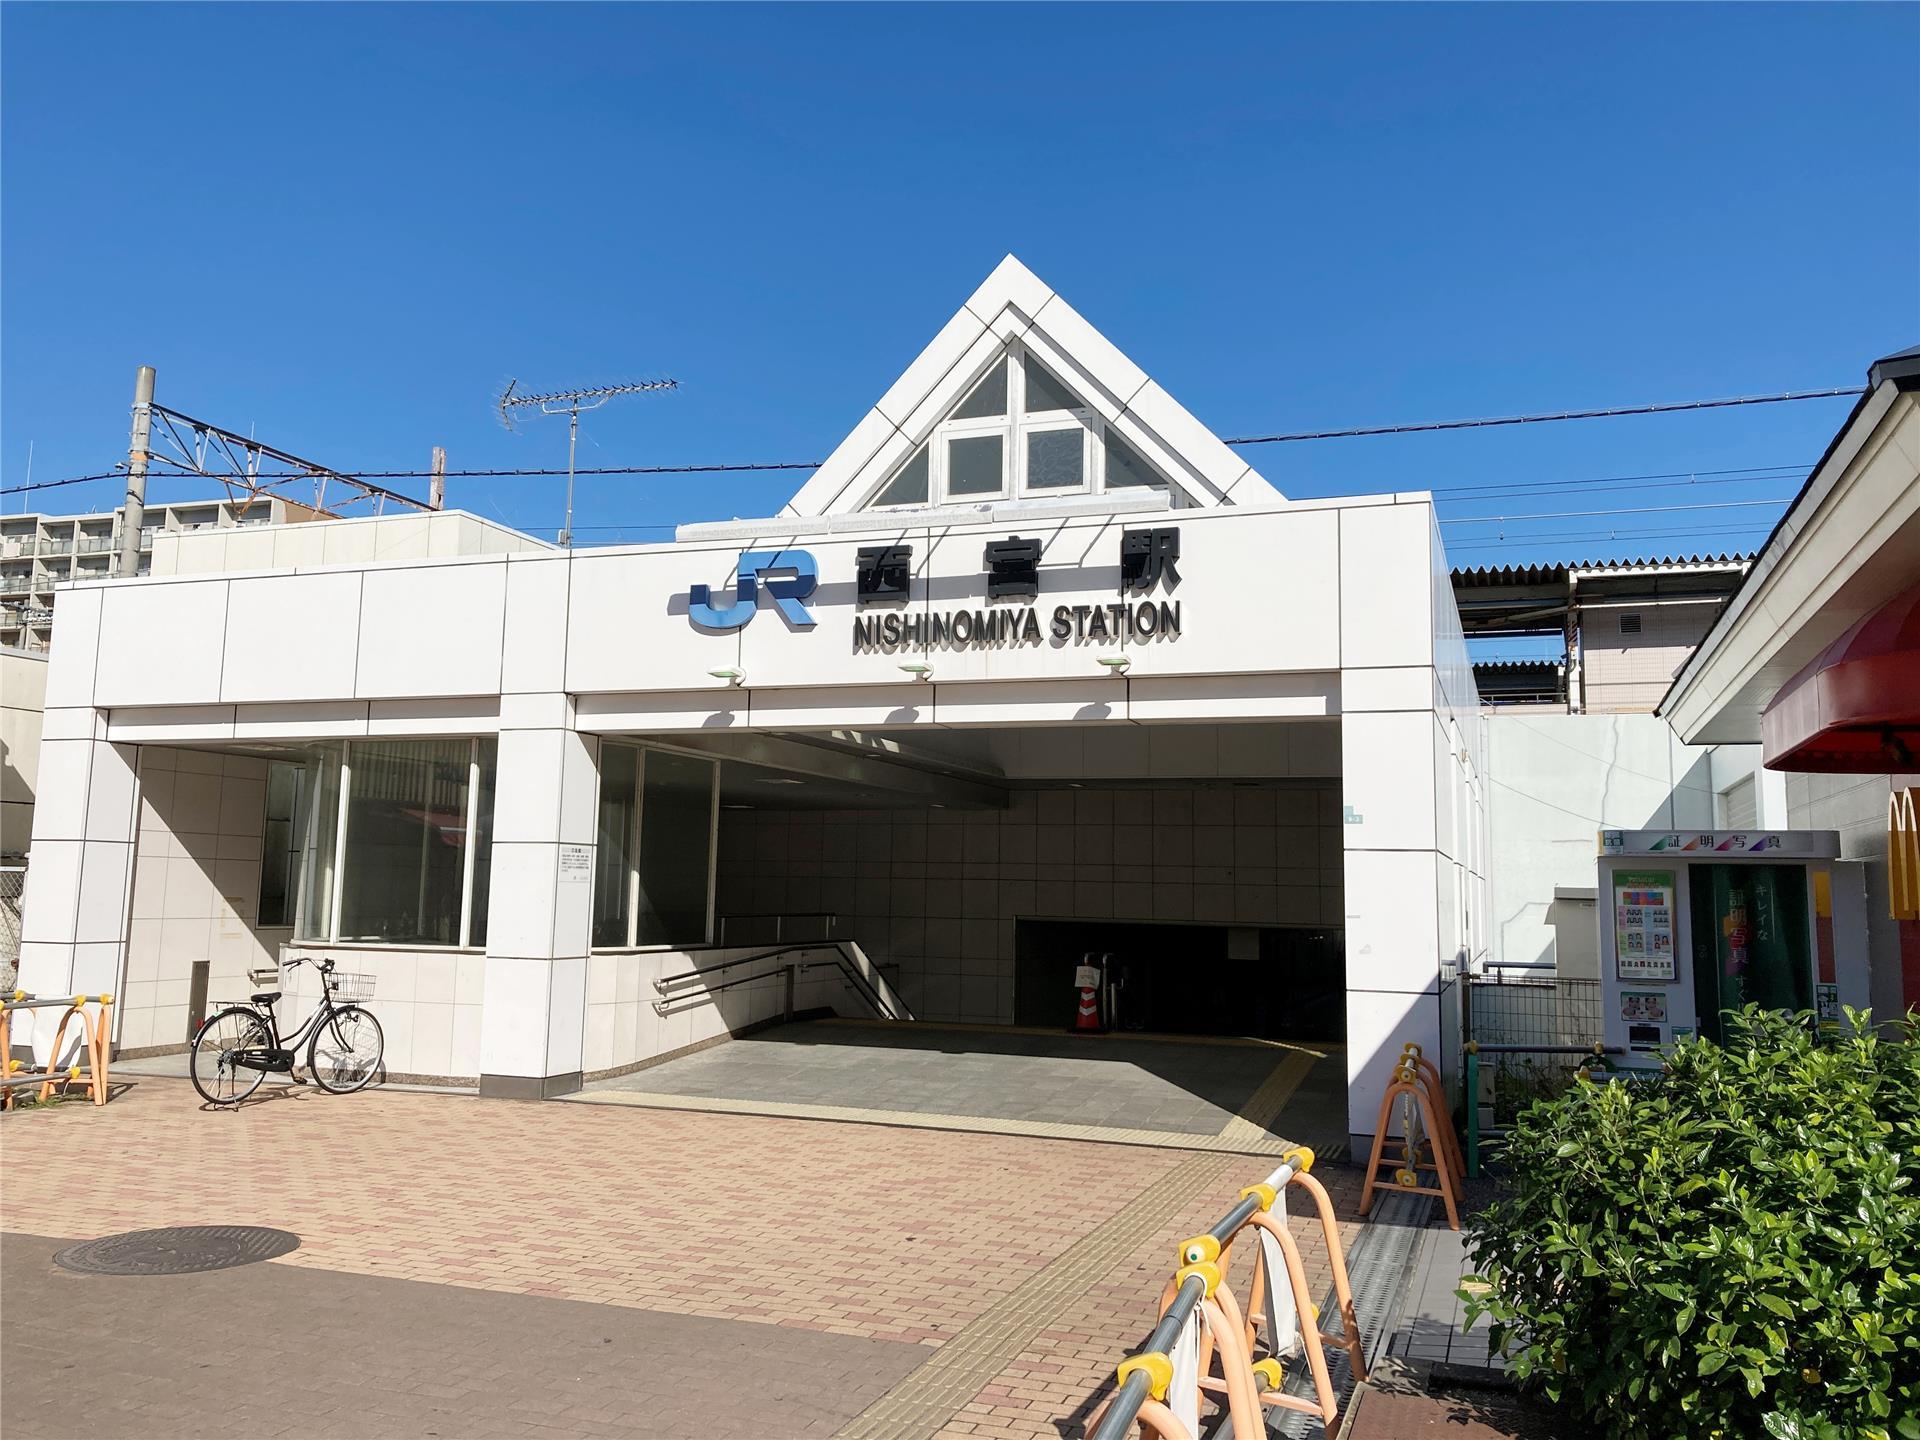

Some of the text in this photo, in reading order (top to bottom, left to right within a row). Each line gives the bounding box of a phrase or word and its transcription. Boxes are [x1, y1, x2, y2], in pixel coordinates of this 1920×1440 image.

[689, 549, 819, 629] JR
[857, 527, 1182, 604] 西宮駅
[854, 600, 1181, 647] NISHINOMIYA STATION
[1668, 834, 1782, 848] 証明写真
[1728, 888, 1750, 965] 証明写真
[1755, 884, 1769, 941] キレイな
